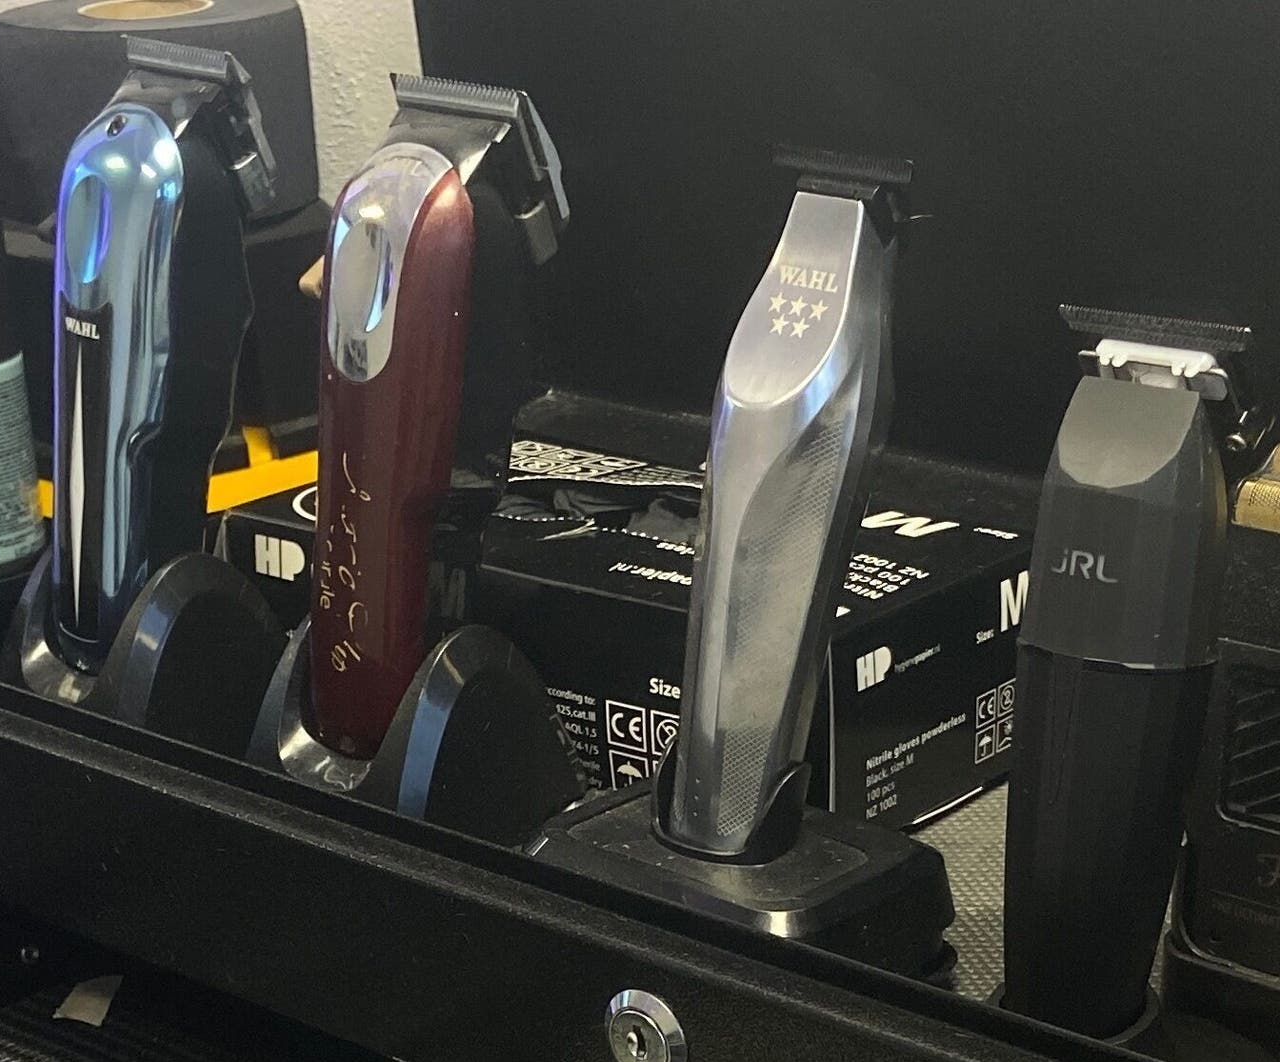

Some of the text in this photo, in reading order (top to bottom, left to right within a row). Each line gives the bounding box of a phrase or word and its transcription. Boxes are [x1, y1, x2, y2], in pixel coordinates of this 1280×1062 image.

[778, 264, 839, 293] WAHL
[64, 316, 101, 340] WAHL
[255, 533, 306, 582] HP
[1051, 548, 1118, 583] JRL
[856, 646, 892, 692] HP
[865, 712, 966, 771] Nitrile gloves powderless
